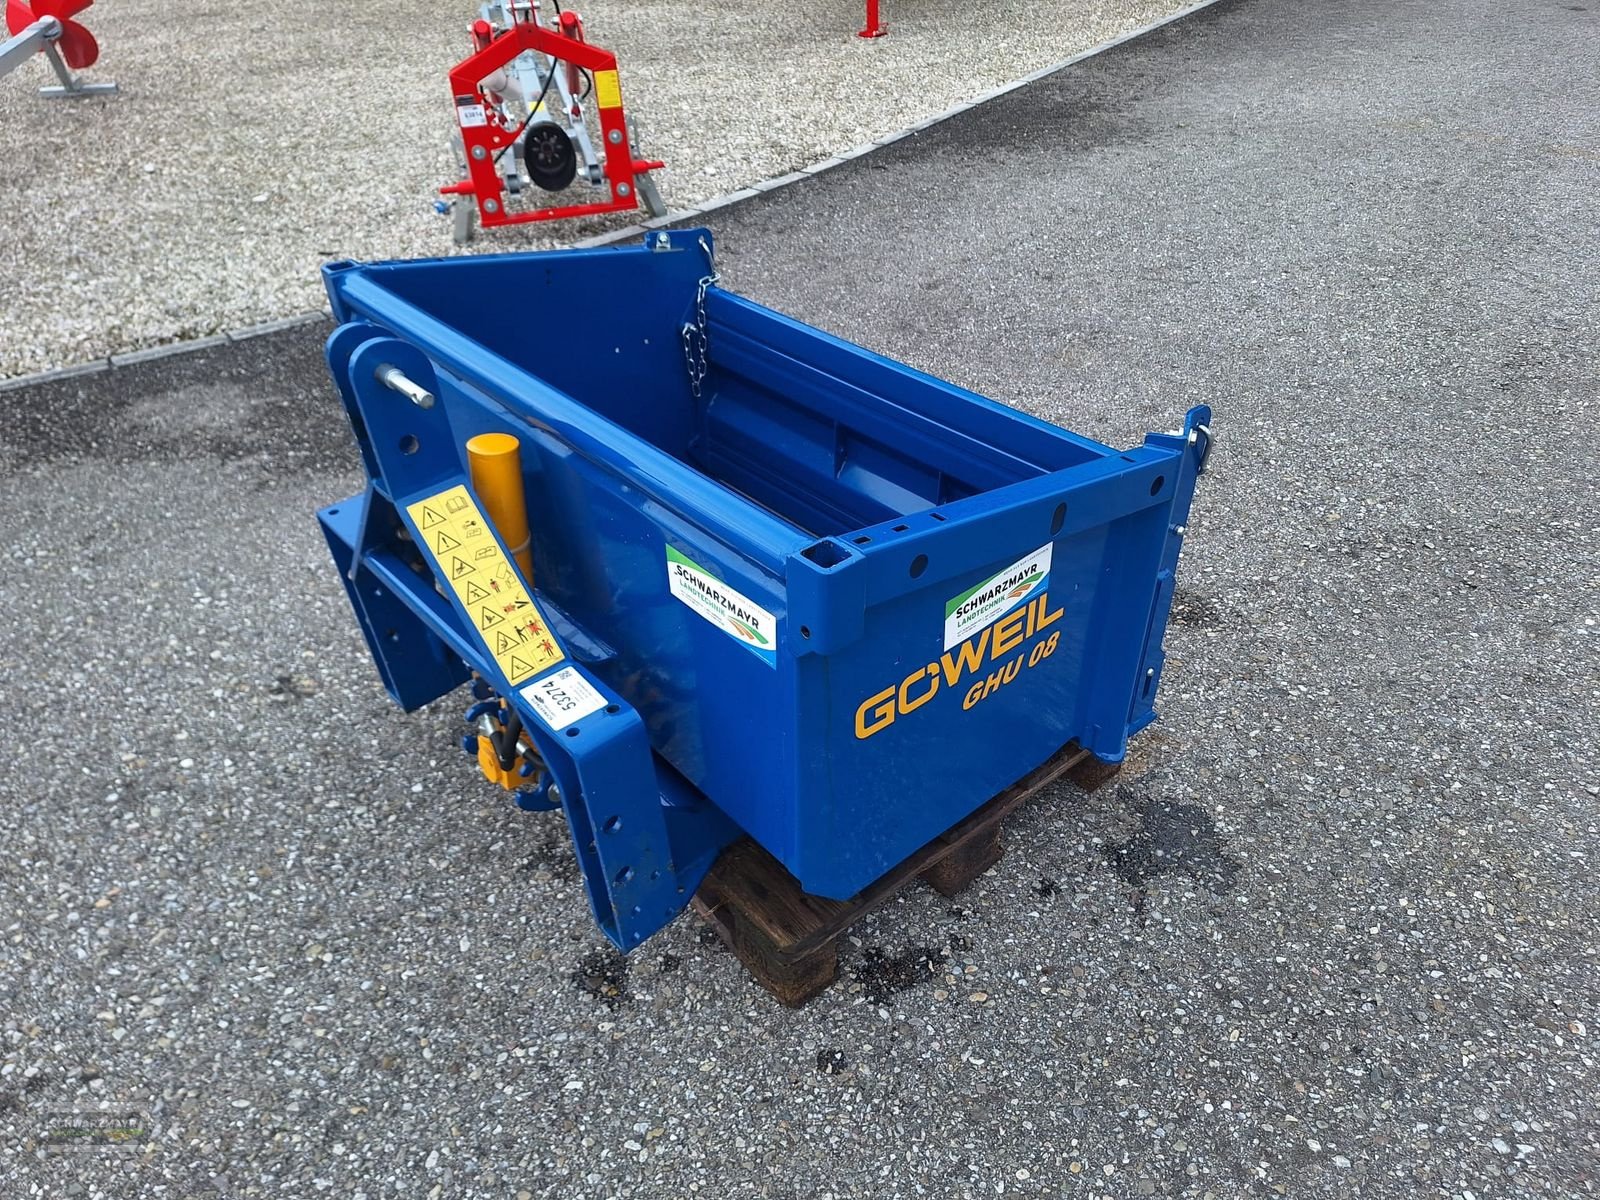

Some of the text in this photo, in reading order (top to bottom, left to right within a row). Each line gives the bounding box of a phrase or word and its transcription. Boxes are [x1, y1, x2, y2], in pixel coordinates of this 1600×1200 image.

[676, 565, 759, 629] SCHWARZMAYR
[680, 579, 726, 617] LANDTECHNIK
[956, 563, 1038, 619] SCHWARZMAYR
[957, 594, 1006, 628] LANDTECHNIK
[962, 630, 1061, 711] GHU 08
[541, 680, 577, 711] 53274
